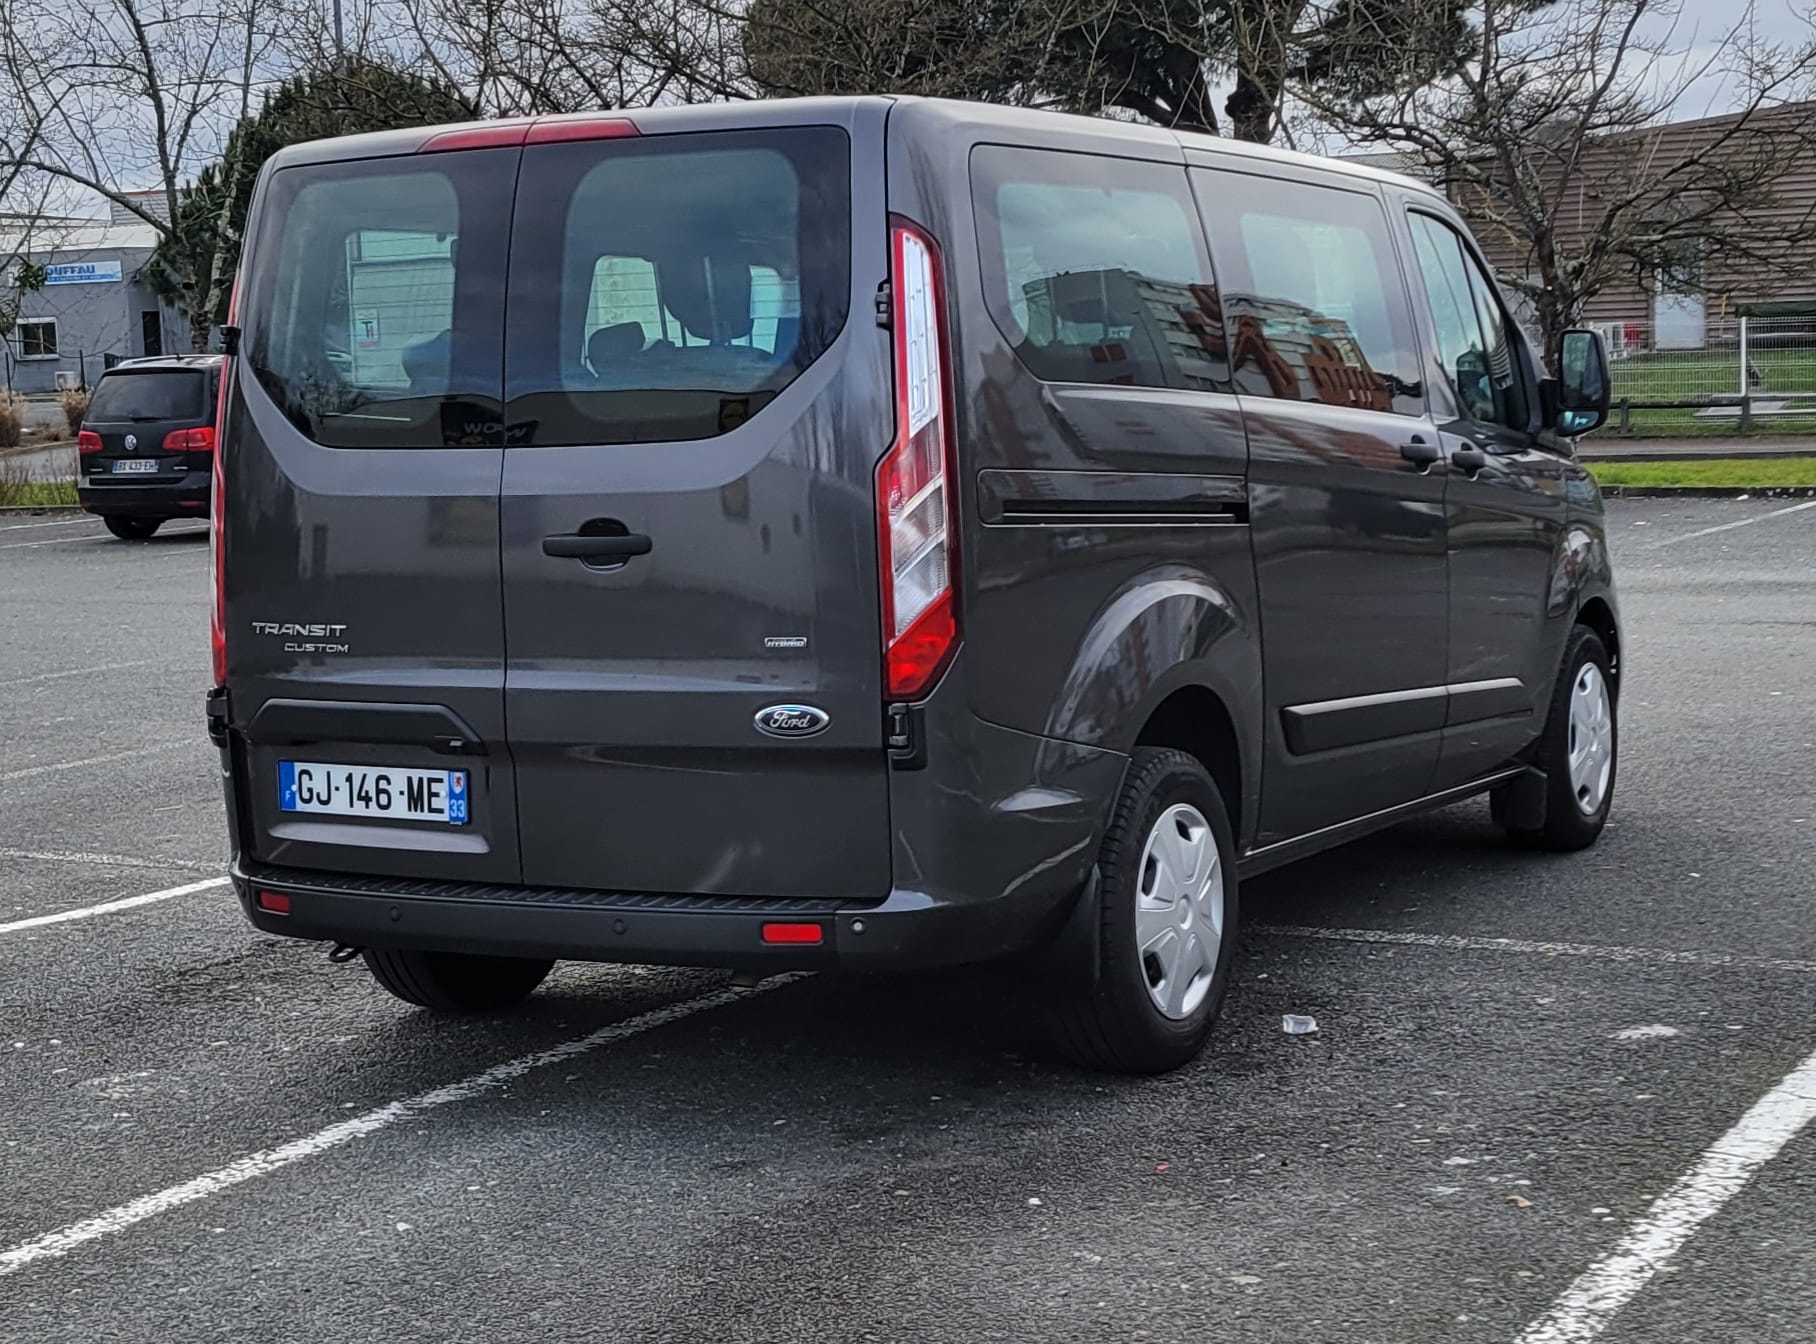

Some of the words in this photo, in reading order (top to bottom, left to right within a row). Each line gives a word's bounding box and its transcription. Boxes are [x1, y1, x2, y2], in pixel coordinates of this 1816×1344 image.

[252, 622, 347, 637] TRANSIT
[284, 642, 349, 653] CUSTOM
[769, 710, 811, 728] Ford
[298, 768, 444, 814] GJ-146-ME
[450, 799, 465, 818] 33
